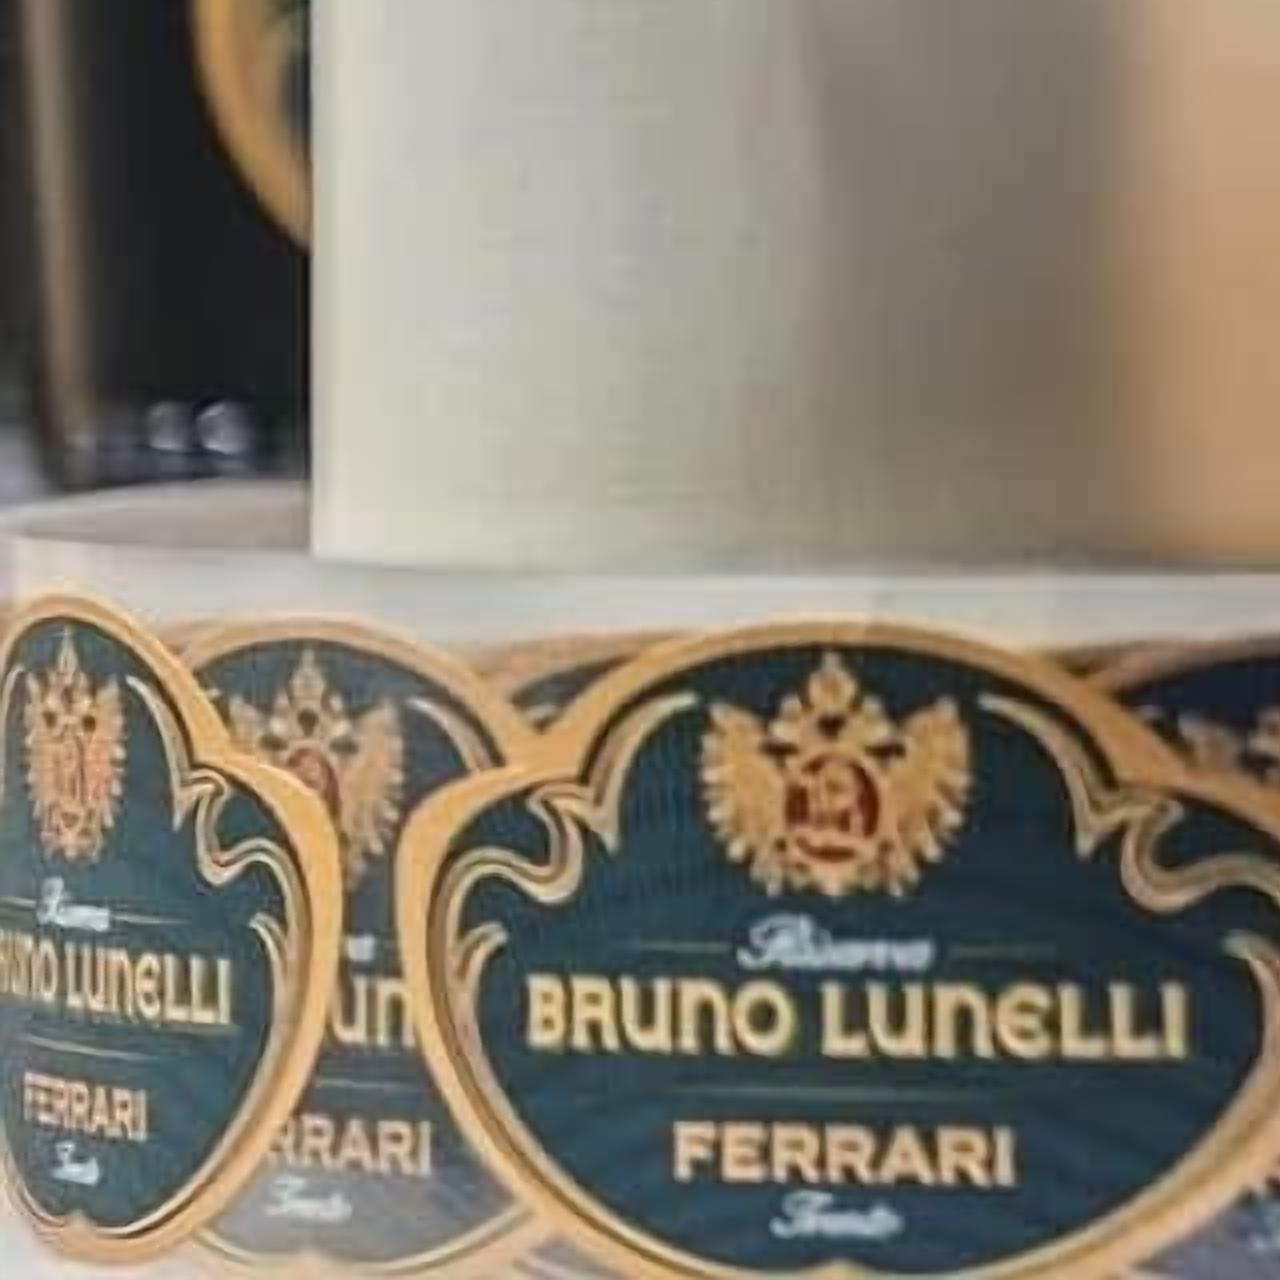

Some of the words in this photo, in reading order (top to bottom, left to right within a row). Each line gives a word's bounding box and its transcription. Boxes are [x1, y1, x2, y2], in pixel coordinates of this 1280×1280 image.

[64, 940, 232, 1025] LUNELLI
[527, 974, 795, 1058] BRUNO
[820, 981, 1192, 1060] LUNELLI
[23, 1070, 149, 1142] FERRARI
[672, 1120, 1018, 1188] FERRARI
